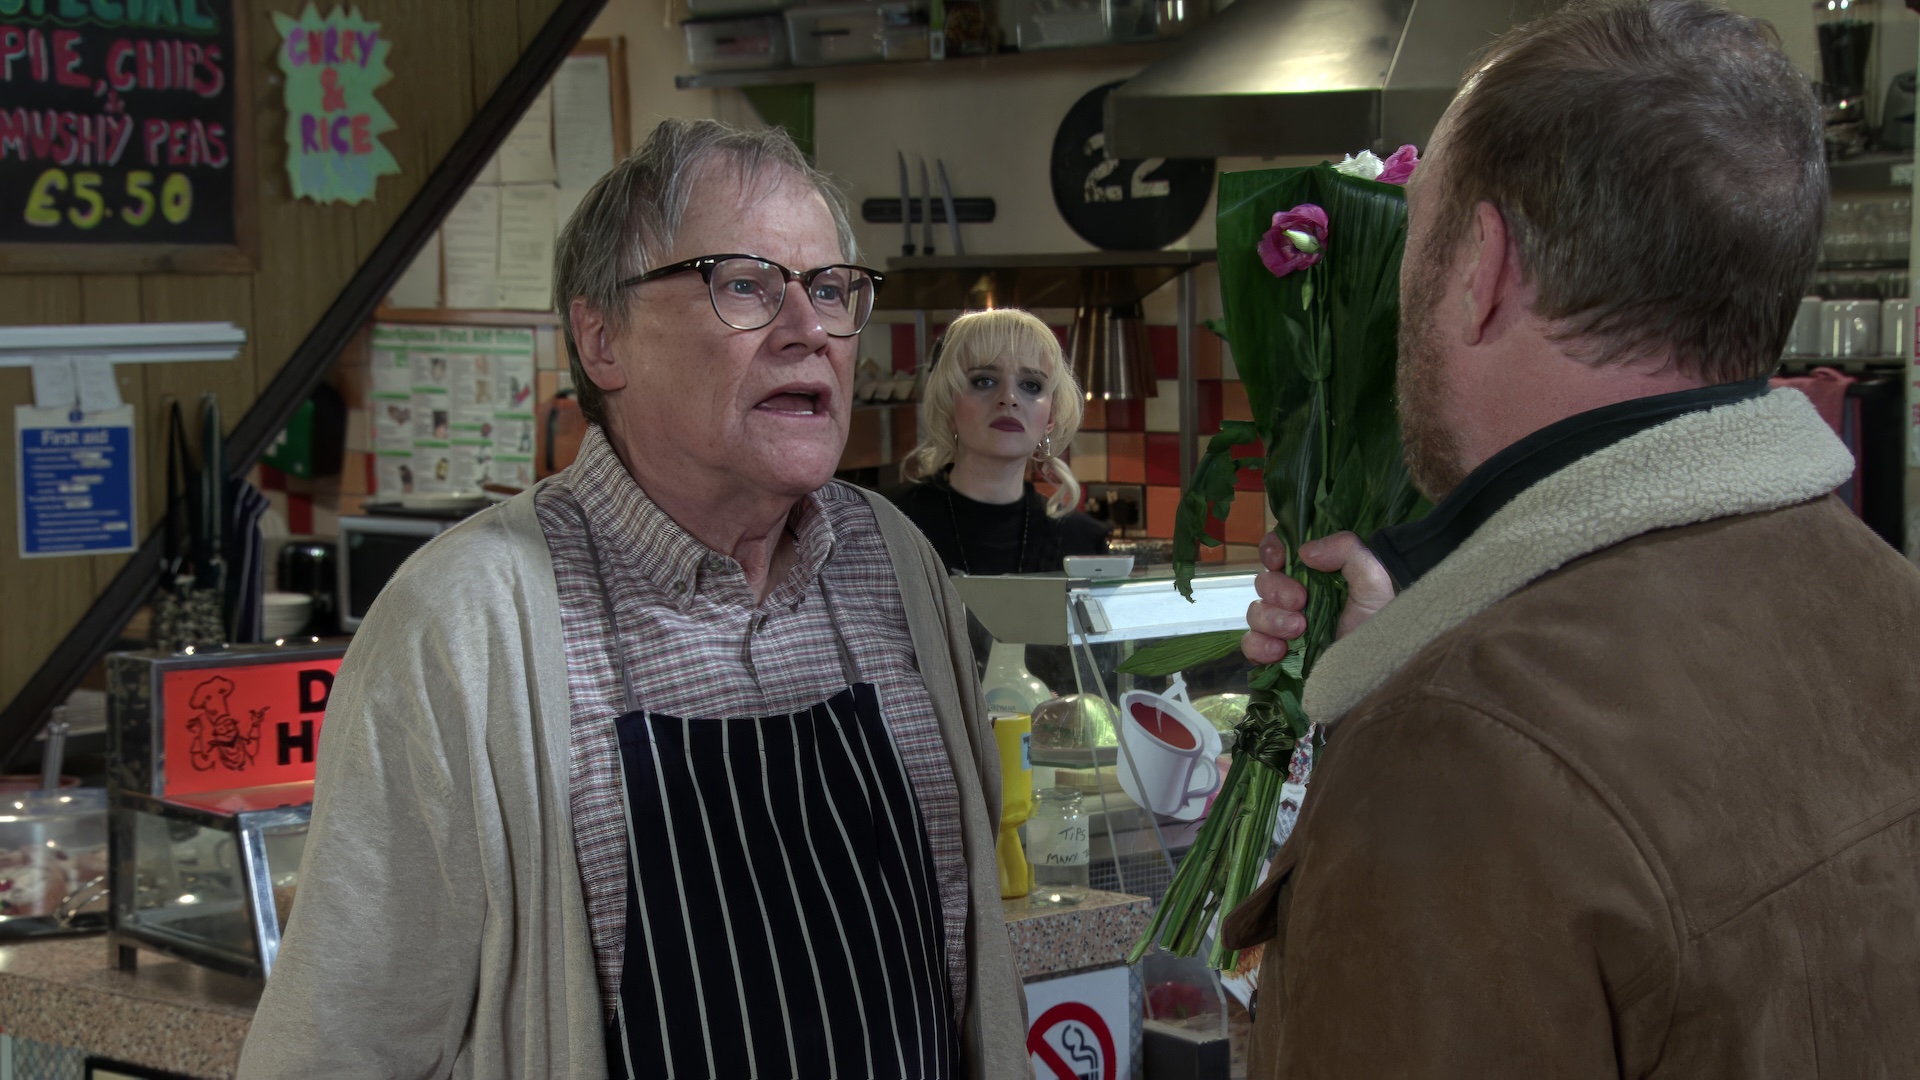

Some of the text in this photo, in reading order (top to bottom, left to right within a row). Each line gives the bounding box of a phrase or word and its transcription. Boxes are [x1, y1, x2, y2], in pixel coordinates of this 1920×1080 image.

[107, 39, 224, 97] CHIPS
[288, 26, 378, 67] CURRY
[319, 68, 347, 113] &
[0, 107, 228, 168] MUSHY PEAS
[301, 113, 374, 155] RICE
[24, 168, 193, 229] £5.50
[41, 430, 109, 446] First aid
[1058, 826, 1086, 842] TIPS
